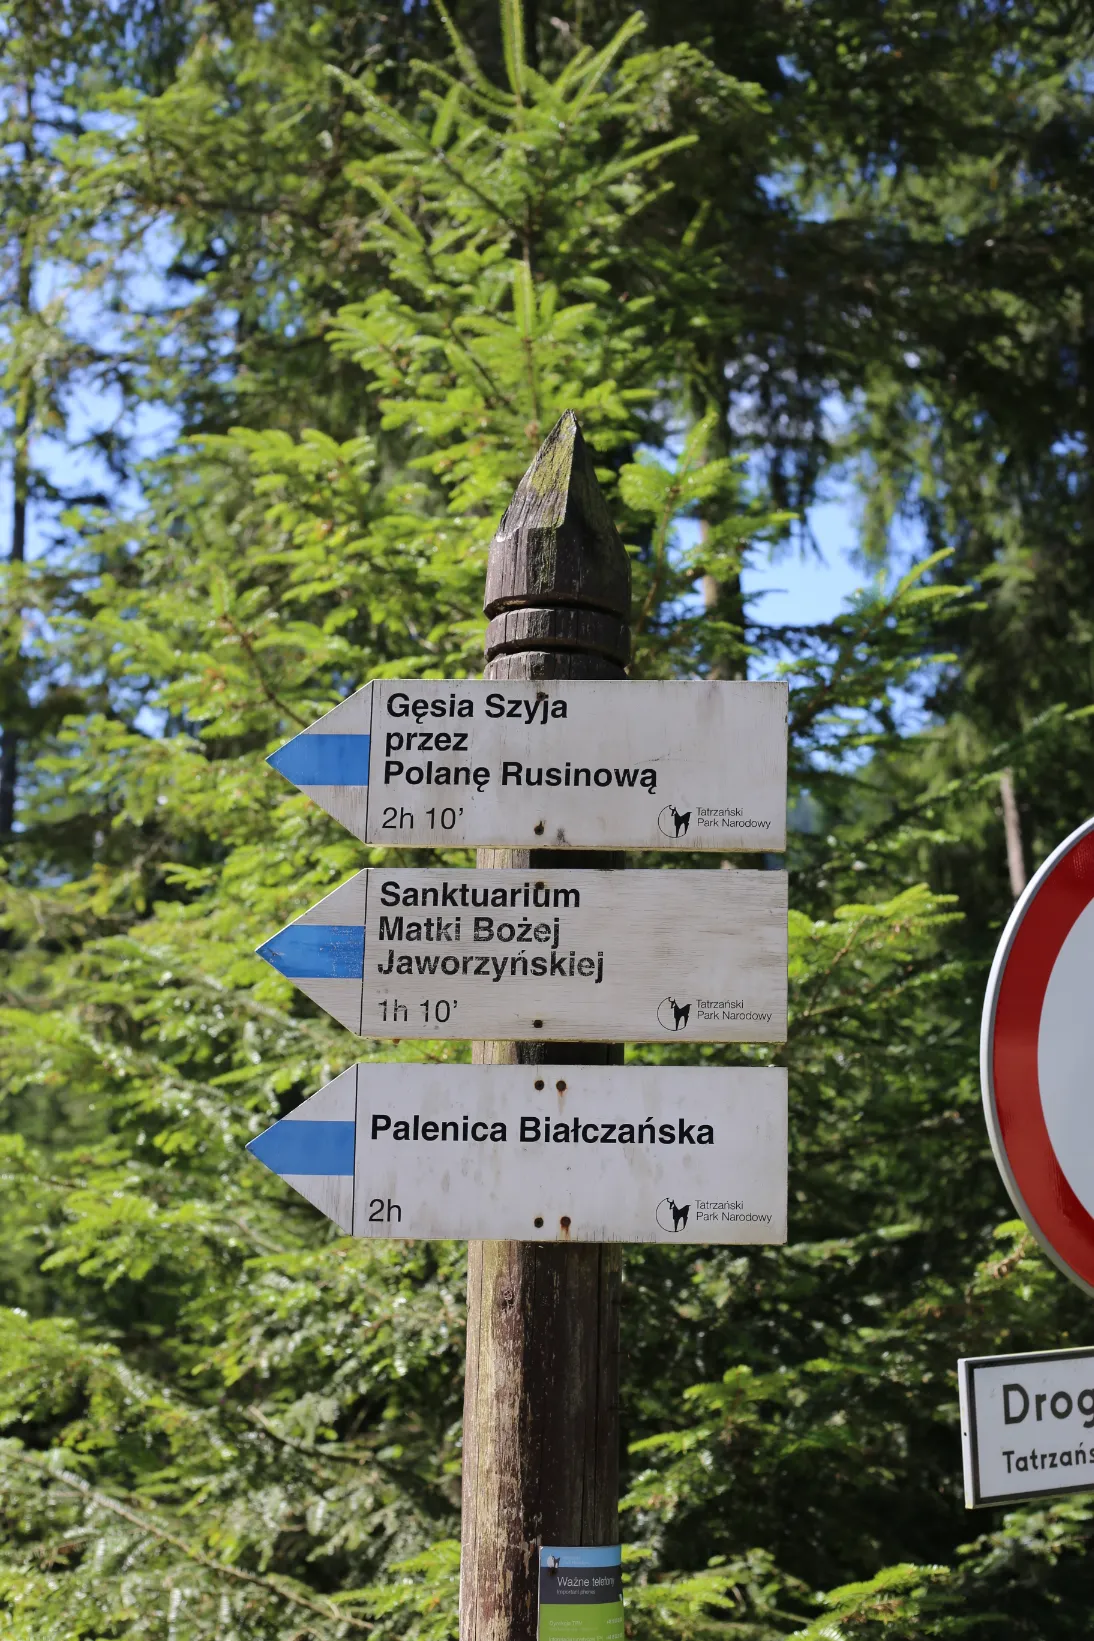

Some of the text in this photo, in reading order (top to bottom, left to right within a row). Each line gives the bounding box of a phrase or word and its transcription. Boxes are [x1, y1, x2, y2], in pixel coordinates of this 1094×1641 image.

[387, 693, 567, 724] Gęsia Szyja
[386, 732, 468, 757] przez
[384, 761, 657, 794] Polanę Rusinową
[382, 807, 413, 829] 2h
[696, 807, 743, 816] Tatrzański
[698, 818, 771, 829] Park Narodowy
[381, 881, 579, 907] Sanktuarium
[379, 916, 559, 948] Matki Bożej
[378, 950, 603, 983] Jaworzyńskiej
[379, 999, 407, 1021] 1h
[696, 1000, 743, 1008] Tatrzański
[698, 1011, 772, 1022] Park Narodowy
[372, 1115, 714, 1144] Palenica Białczańska
[369, 1199, 401, 1222] 2h
[695, 1200, 743, 1209] Tatrzański
[697, 1212, 772, 1223] Park Narodowy
[1003, 1384, 1094, 1428] Drog
[557, 1576, 615, 1588] Ważne telefony
